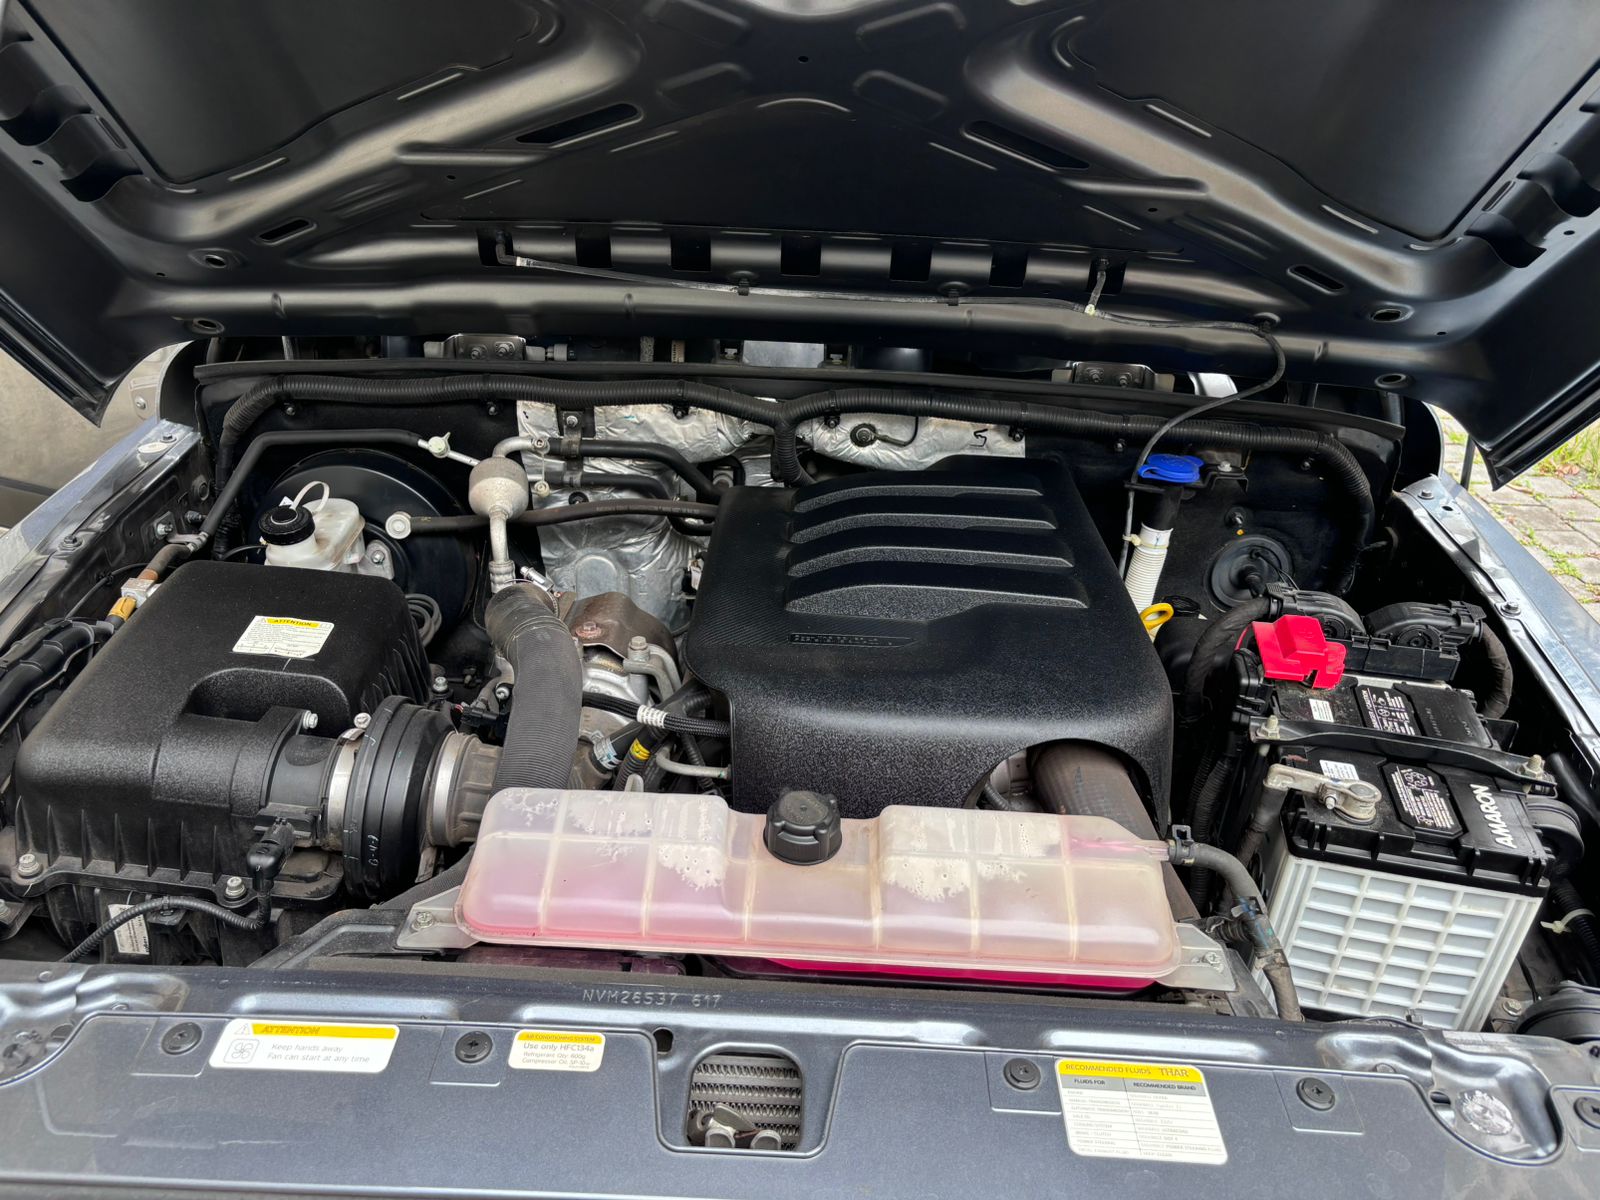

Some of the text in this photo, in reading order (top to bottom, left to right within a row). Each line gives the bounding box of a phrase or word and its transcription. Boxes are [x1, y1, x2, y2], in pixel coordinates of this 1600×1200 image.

[273, 619, 312, 627] ATTENTION
[1469, 784, 1517, 849] AMARON
[261, 1025, 321, 1035] ATTENTION
[271, 1043, 343, 1053] Keep hands away
[540, 1043, 558, 1051] only
[560, 1044, 595, 1052] HFC134a
[300, 1053, 321, 1061] start
[334, 1055, 349, 1063] any
[351, 1055, 370, 1063] time
[1065, 1063, 1189, 1077] RECOMMENDED FLUIDS THAR
